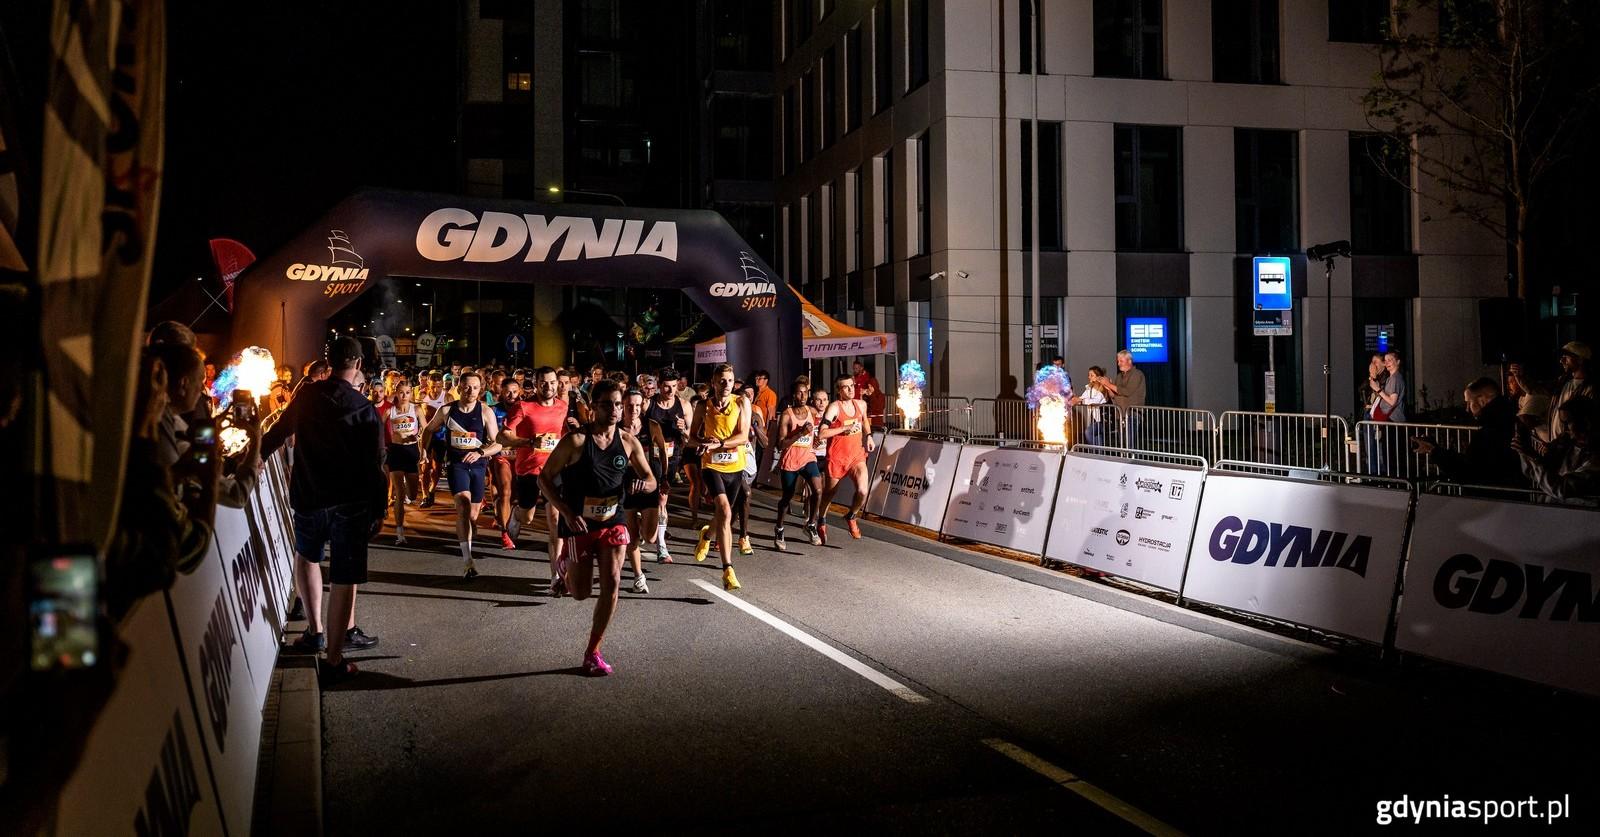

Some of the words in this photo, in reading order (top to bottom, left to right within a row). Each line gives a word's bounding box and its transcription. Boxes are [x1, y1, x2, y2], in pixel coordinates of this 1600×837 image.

[416, 207, 678, 263] GDYNIA
[286, 263, 369, 281] GDYNIA
[324, 280, 365, 298] sport
[709, 282, 777, 297] GDYNIA
[741, 294, 777, 311] sport
[1131, 324, 1163, 338] EIS
[804, 341, 865, 352] -TIMING.PL
[879, 470, 922, 491] RADMOR
[1208, 515, 1373, 578] GDYNIA
[1433, 553, 1600, 622] GDYN
